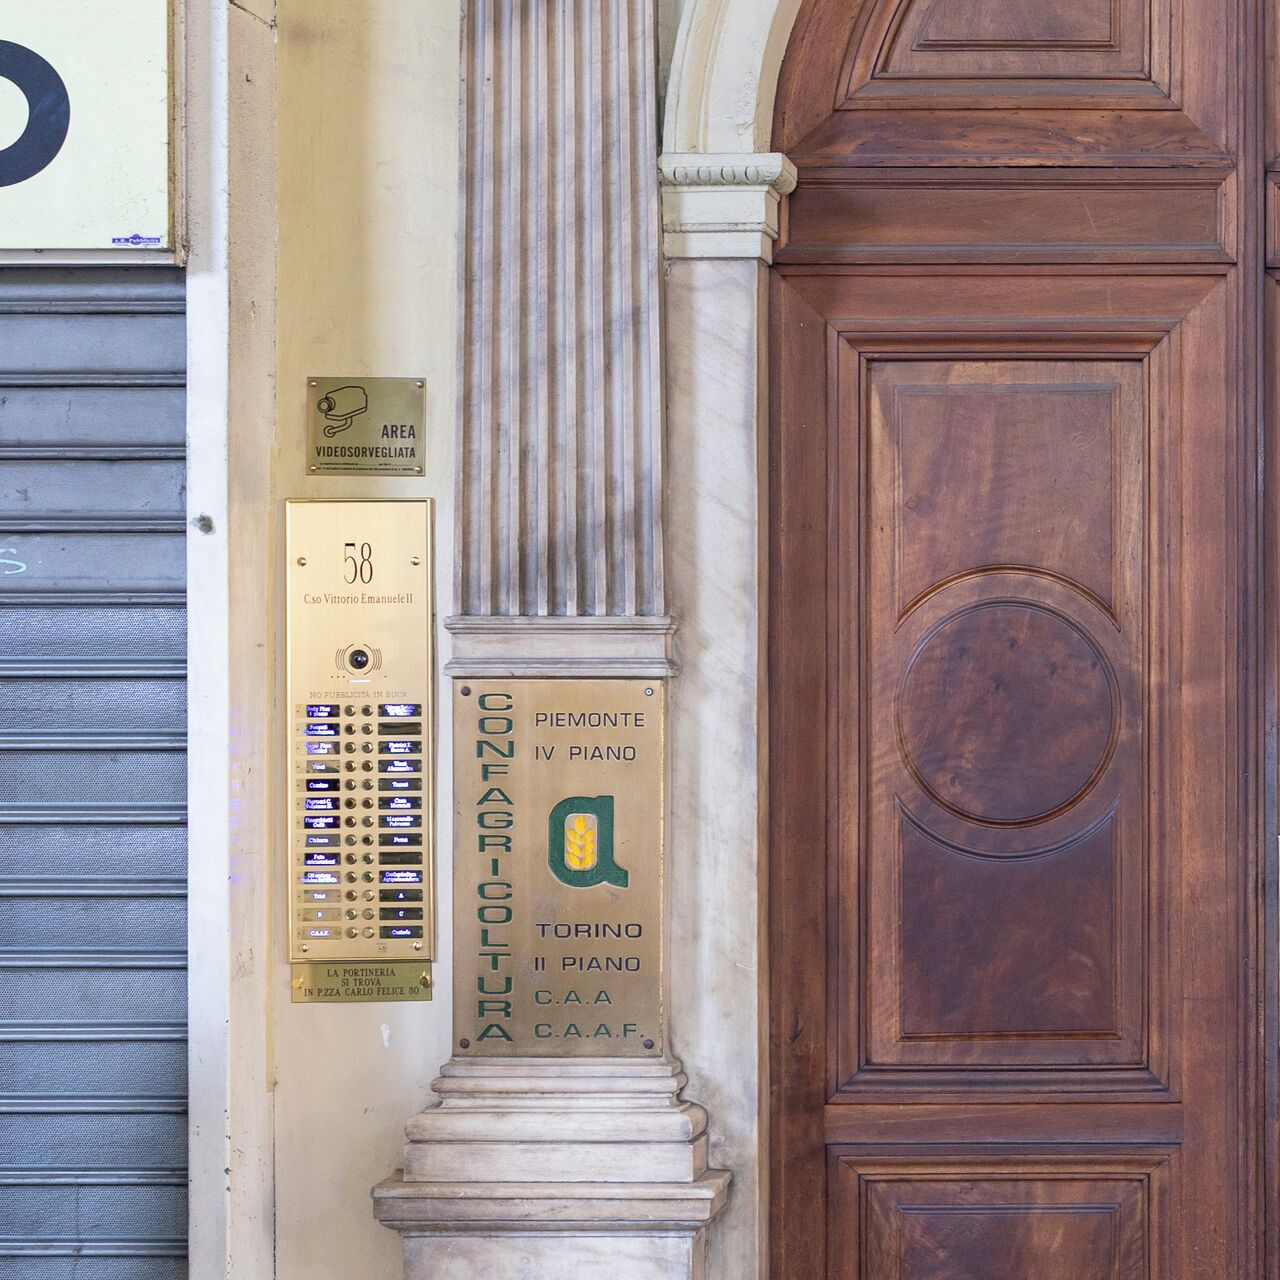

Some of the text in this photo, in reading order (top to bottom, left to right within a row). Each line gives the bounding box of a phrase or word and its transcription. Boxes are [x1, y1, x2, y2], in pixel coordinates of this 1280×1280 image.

[381, 424, 416, 439] AREA
[316, 446, 416, 458] VIDEOSORVEGLIATA
[343, 542, 373, 584] 58
[303, 593, 322, 605] C.so
[324, 593, 360, 605] Vittorio
[361, 593, 406, 604] Emanuele
[309, 691, 322, 699] NO
[535, 712, 645, 727] PIEMONTE
[535, 746, 637, 761] IV PIANO
[475, 693, 515, 1042] CONFAGRICOLTURA
[535, 923, 642, 938] TORINO
[534, 956, 641, 971] II PIANO
[327, 968, 396, 977] LA PORTINERIA
[341, 978, 381, 987] SI TROVA
[304, 988, 313, 997] IN
[345, 987, 373, 996] CARLO
[377, 987, 405, 996] FELICE
[534, 989, 613, 1005] C.A.A
[534, 1023, 645, 1039] C.A.A.F.
